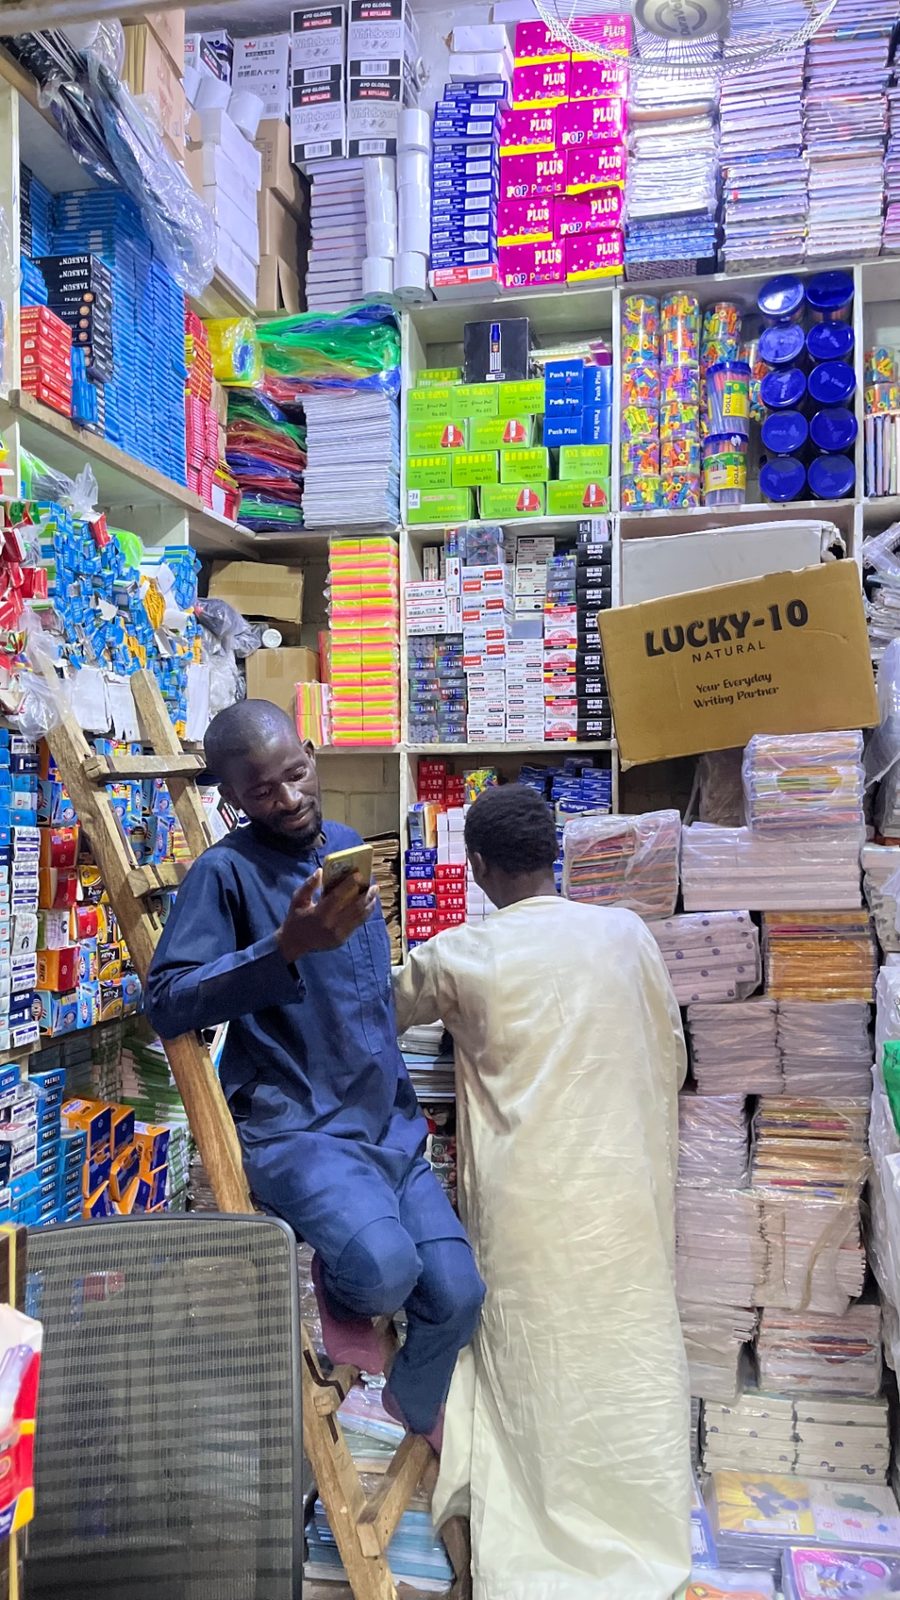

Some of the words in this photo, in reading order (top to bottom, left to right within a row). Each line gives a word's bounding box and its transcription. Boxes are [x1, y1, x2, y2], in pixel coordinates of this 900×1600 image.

[352, 28, 400, 39] Whiteboard
[603, 26, 626, 37] PLUS
[294, 37, 340, 49] Whiteboard
[543, 72, 566, 85] PLUS
[601, 70, 623, 82] PLUS
[534, 89, 565, 98] Pencils
[294, 111, 340, 123] Whiteboard
[351, 106, 397, 118] Whiteboard
[593, 108, 621, 123] PLUS
[530, 119, 552, 131] PLUS
[521, 135, 552, 144] Pencils
[562, 132, 583, 143] POP
[587, 129, 618, 139] Pencils
[536, 159, 563, 175] PLUS
[598, 154, 621, 169] PLUS
[590, 172, 620, 182] Pencils
[507, 185, 527, 197] POP
[531, 183, 561, 194] Pencils
[591, 197, 618, 214] PLUS
[527, 208, 549, 221] PLUS
[519, 225, 548, 234] Pencils
[560, 222, 581, 235] POP
[585, 220, 616, 229] Pencils
[597, 241, 619, 255] PLUS
[534, 249, 561, 265] PLUS
[589, 258, 619, 268] Pencils
[506, 274, 526, 285] POP
[530, 272, 560, 282] Pencils
[644, 598, 810, 657] LUCKY-10
[692, 640, 766, 664] NATURAL
[696, 682, 720, 694] Your
[723, 672, 772, 689] Everyday
[693, 694, 734, 710] Writing
[737, 686, 780, 700] Partner
